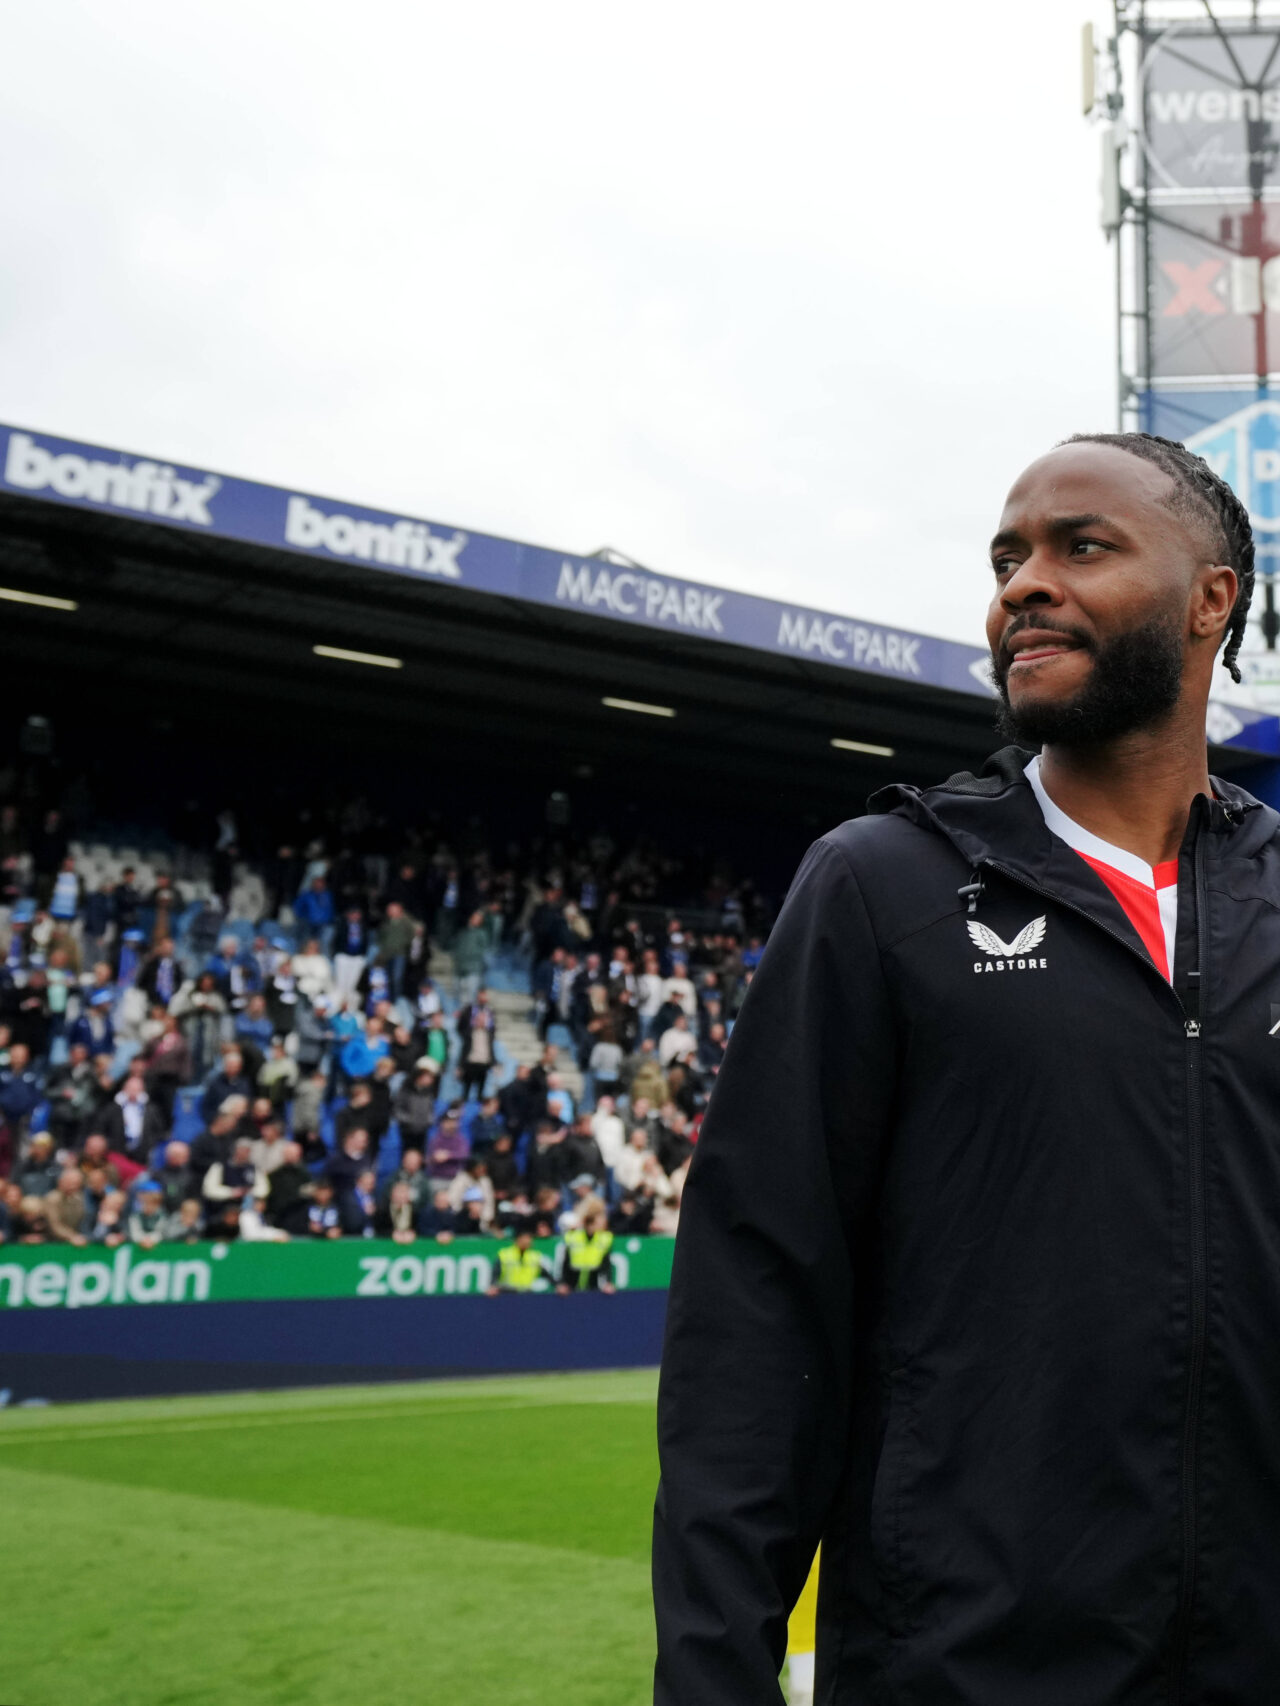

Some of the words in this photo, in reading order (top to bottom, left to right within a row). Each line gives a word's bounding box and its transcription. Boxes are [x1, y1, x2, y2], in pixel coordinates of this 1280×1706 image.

[5, 433, 215, 526] bonfix
[286, 495, 463, 579] bonfix
[973, 957, 1048, 974] CASTORE
[0, 1244, 212, 1309] neplan
